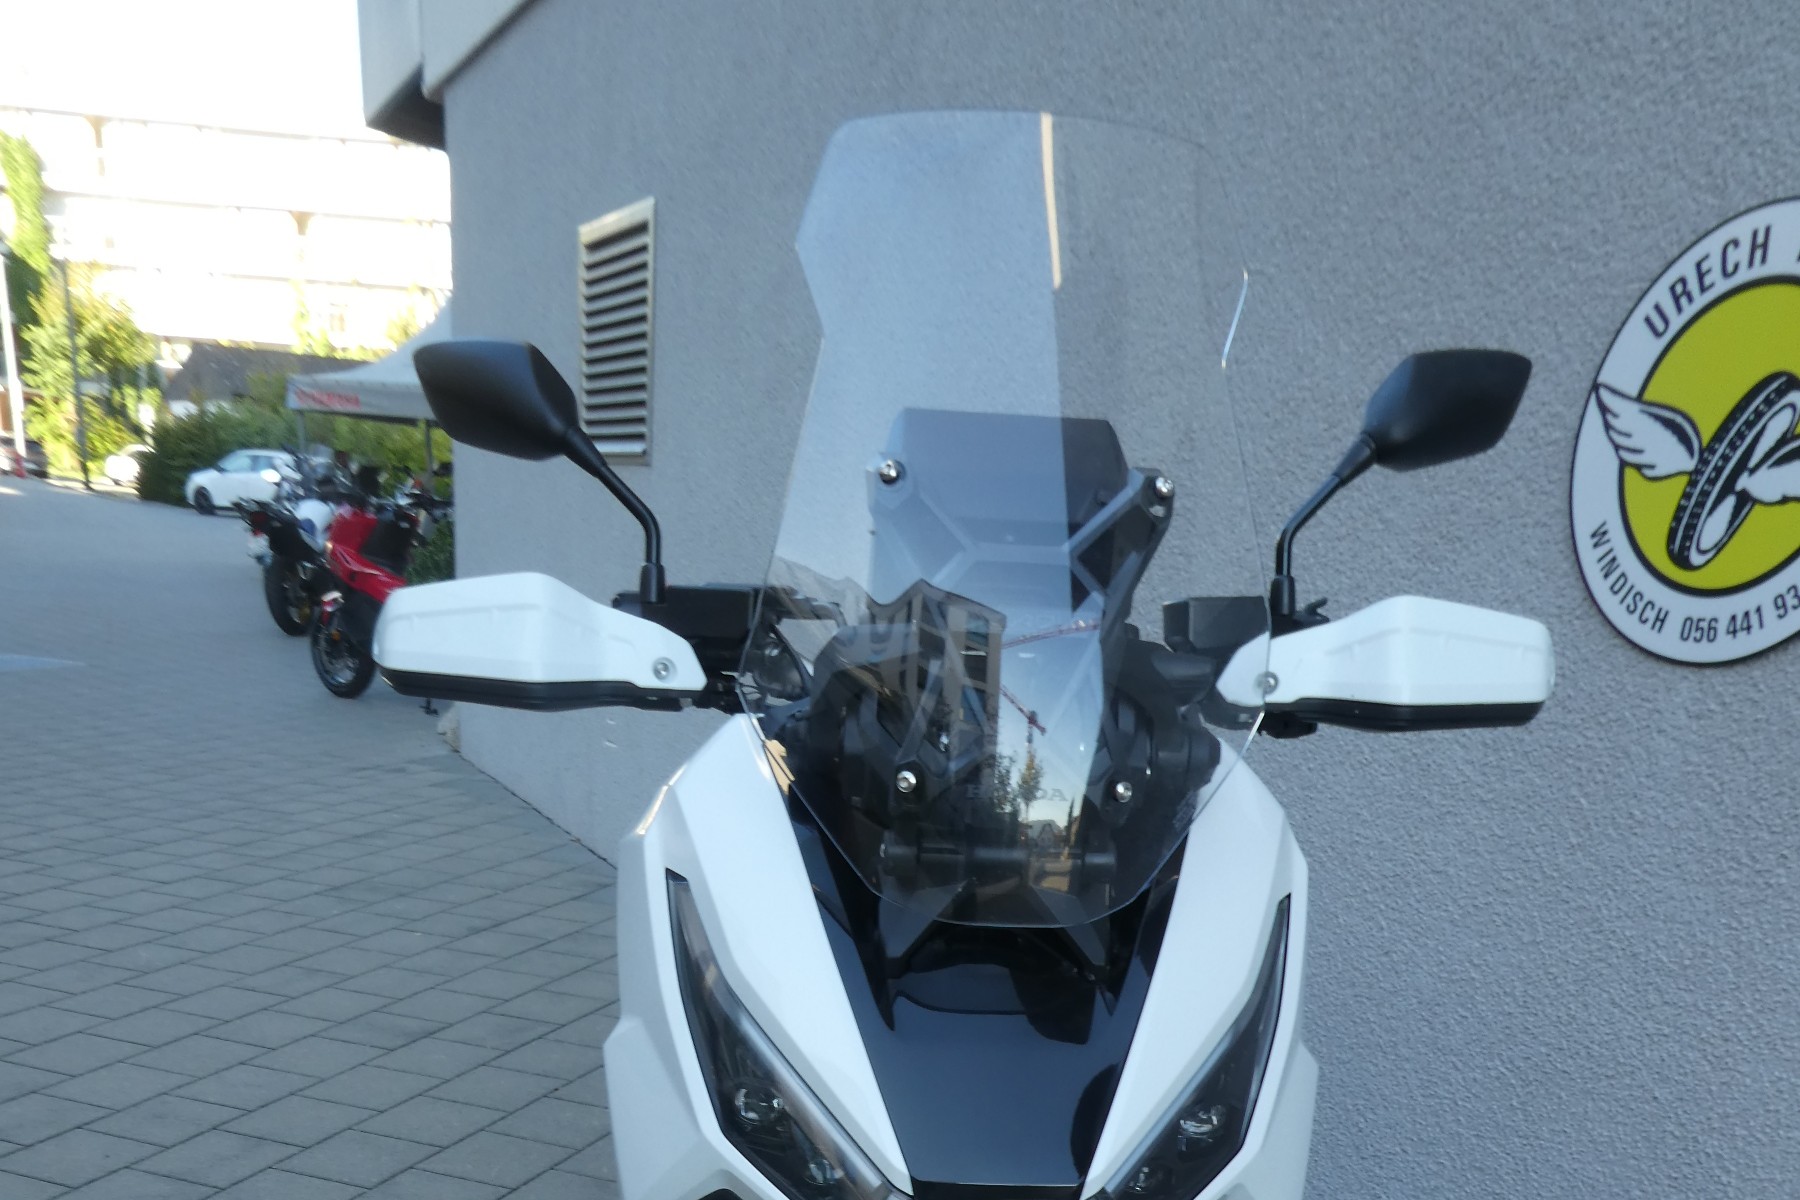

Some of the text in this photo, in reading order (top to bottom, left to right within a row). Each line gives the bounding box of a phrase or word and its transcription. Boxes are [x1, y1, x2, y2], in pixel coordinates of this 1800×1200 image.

[1644, 224, 1772, 339] URECH
[1590, 520, 1800, 643] WINDISCH 056 441 93
